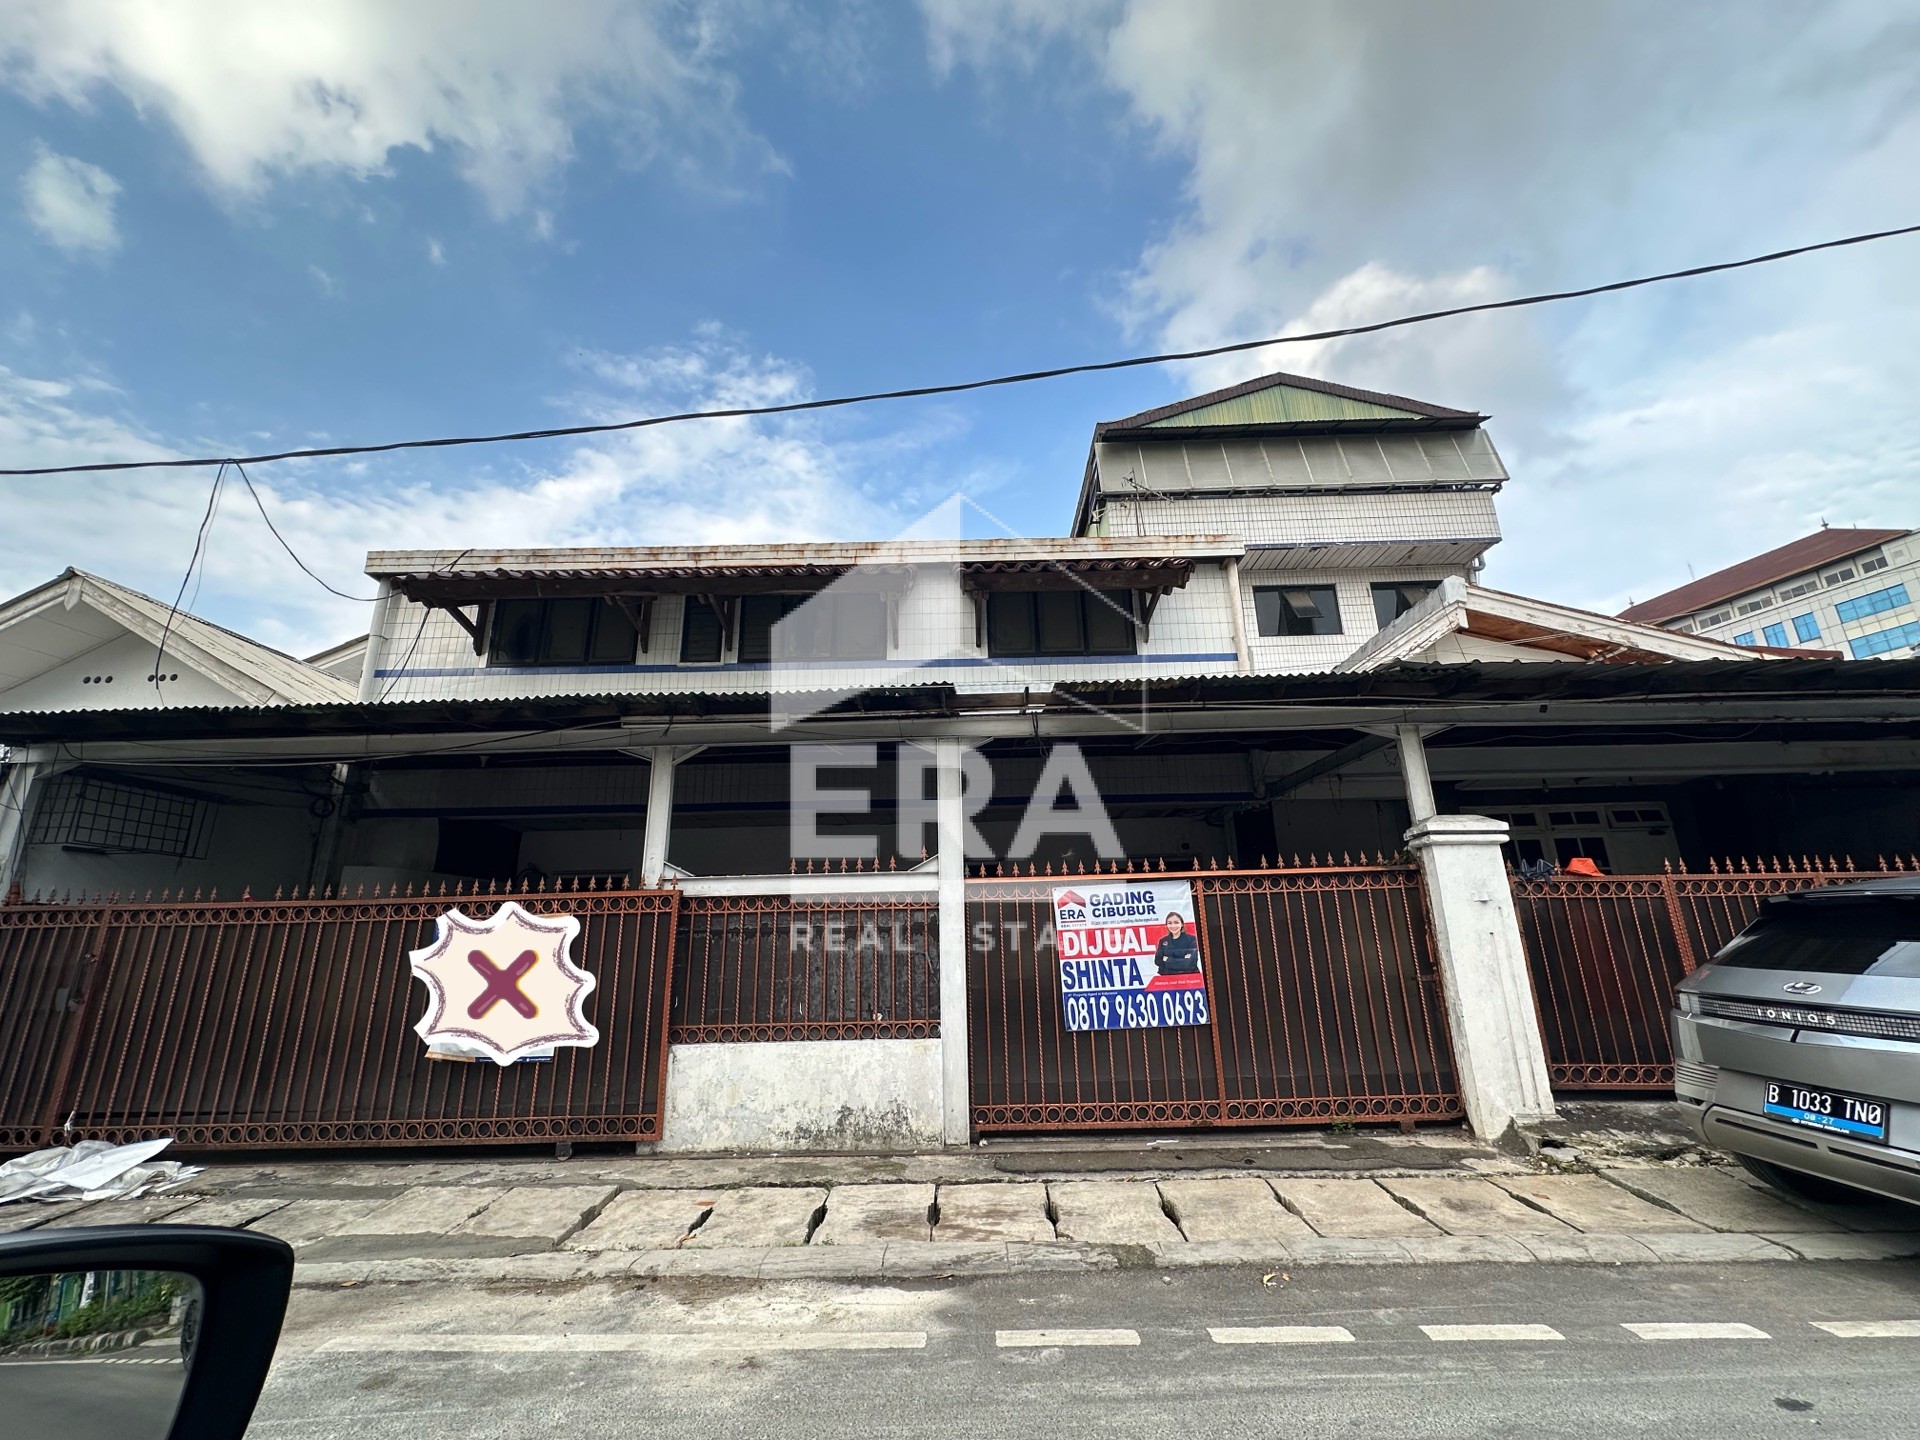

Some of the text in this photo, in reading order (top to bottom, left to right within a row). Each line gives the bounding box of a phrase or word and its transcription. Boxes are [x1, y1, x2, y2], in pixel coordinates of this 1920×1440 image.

[1089, 890, 1154, 907] GADING
[1060, 908, 1086, 920] ERA
[1092, 904, 1156, 918] CIBUBUR
[1062, 927, 1156, 956] DIJUAL
[1062, 958, 1144, 990] SHINTA
[1067, 990, 1207, 1031] 0819 9630 0693
[1757, 1008, 1835, 1025] IONIQ 5
[1768, 1084, 1779, 1103] B
[1792, 1089, 1831, 1114] 1033
